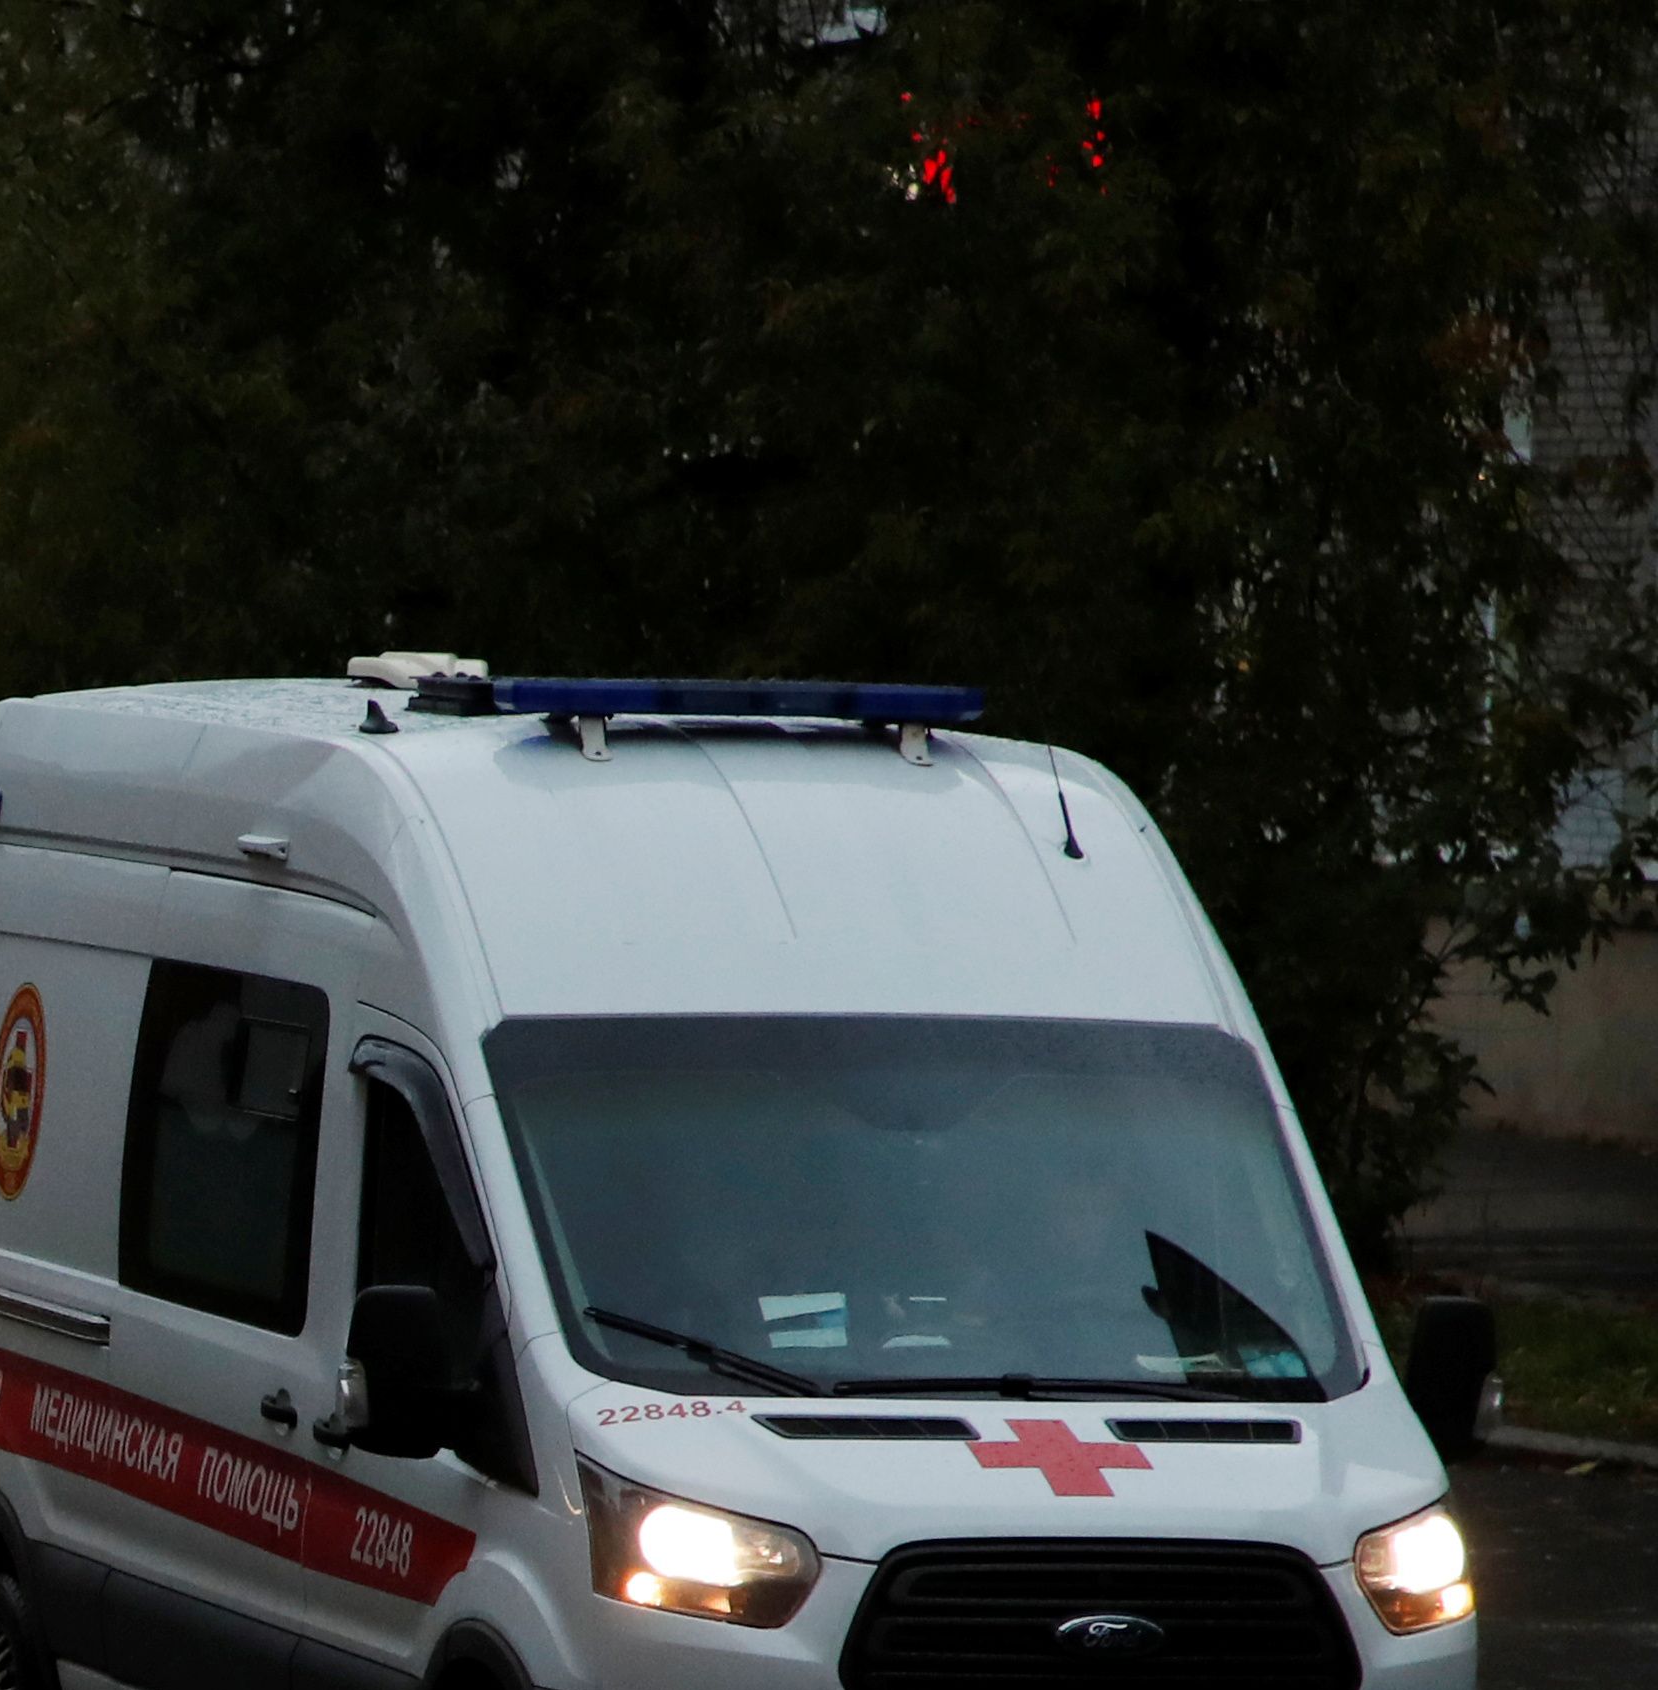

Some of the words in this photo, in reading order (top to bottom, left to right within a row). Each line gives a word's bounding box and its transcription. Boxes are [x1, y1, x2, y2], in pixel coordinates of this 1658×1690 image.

[597, 1399, 747, 1426] 22848.4
[30, 1382, 183, 1484] МЕДИЦИНСКАЯ
[197, 1445, 300, 1537] ПОМОЩЬ
[349, 1505, 414, 1578] 22848
